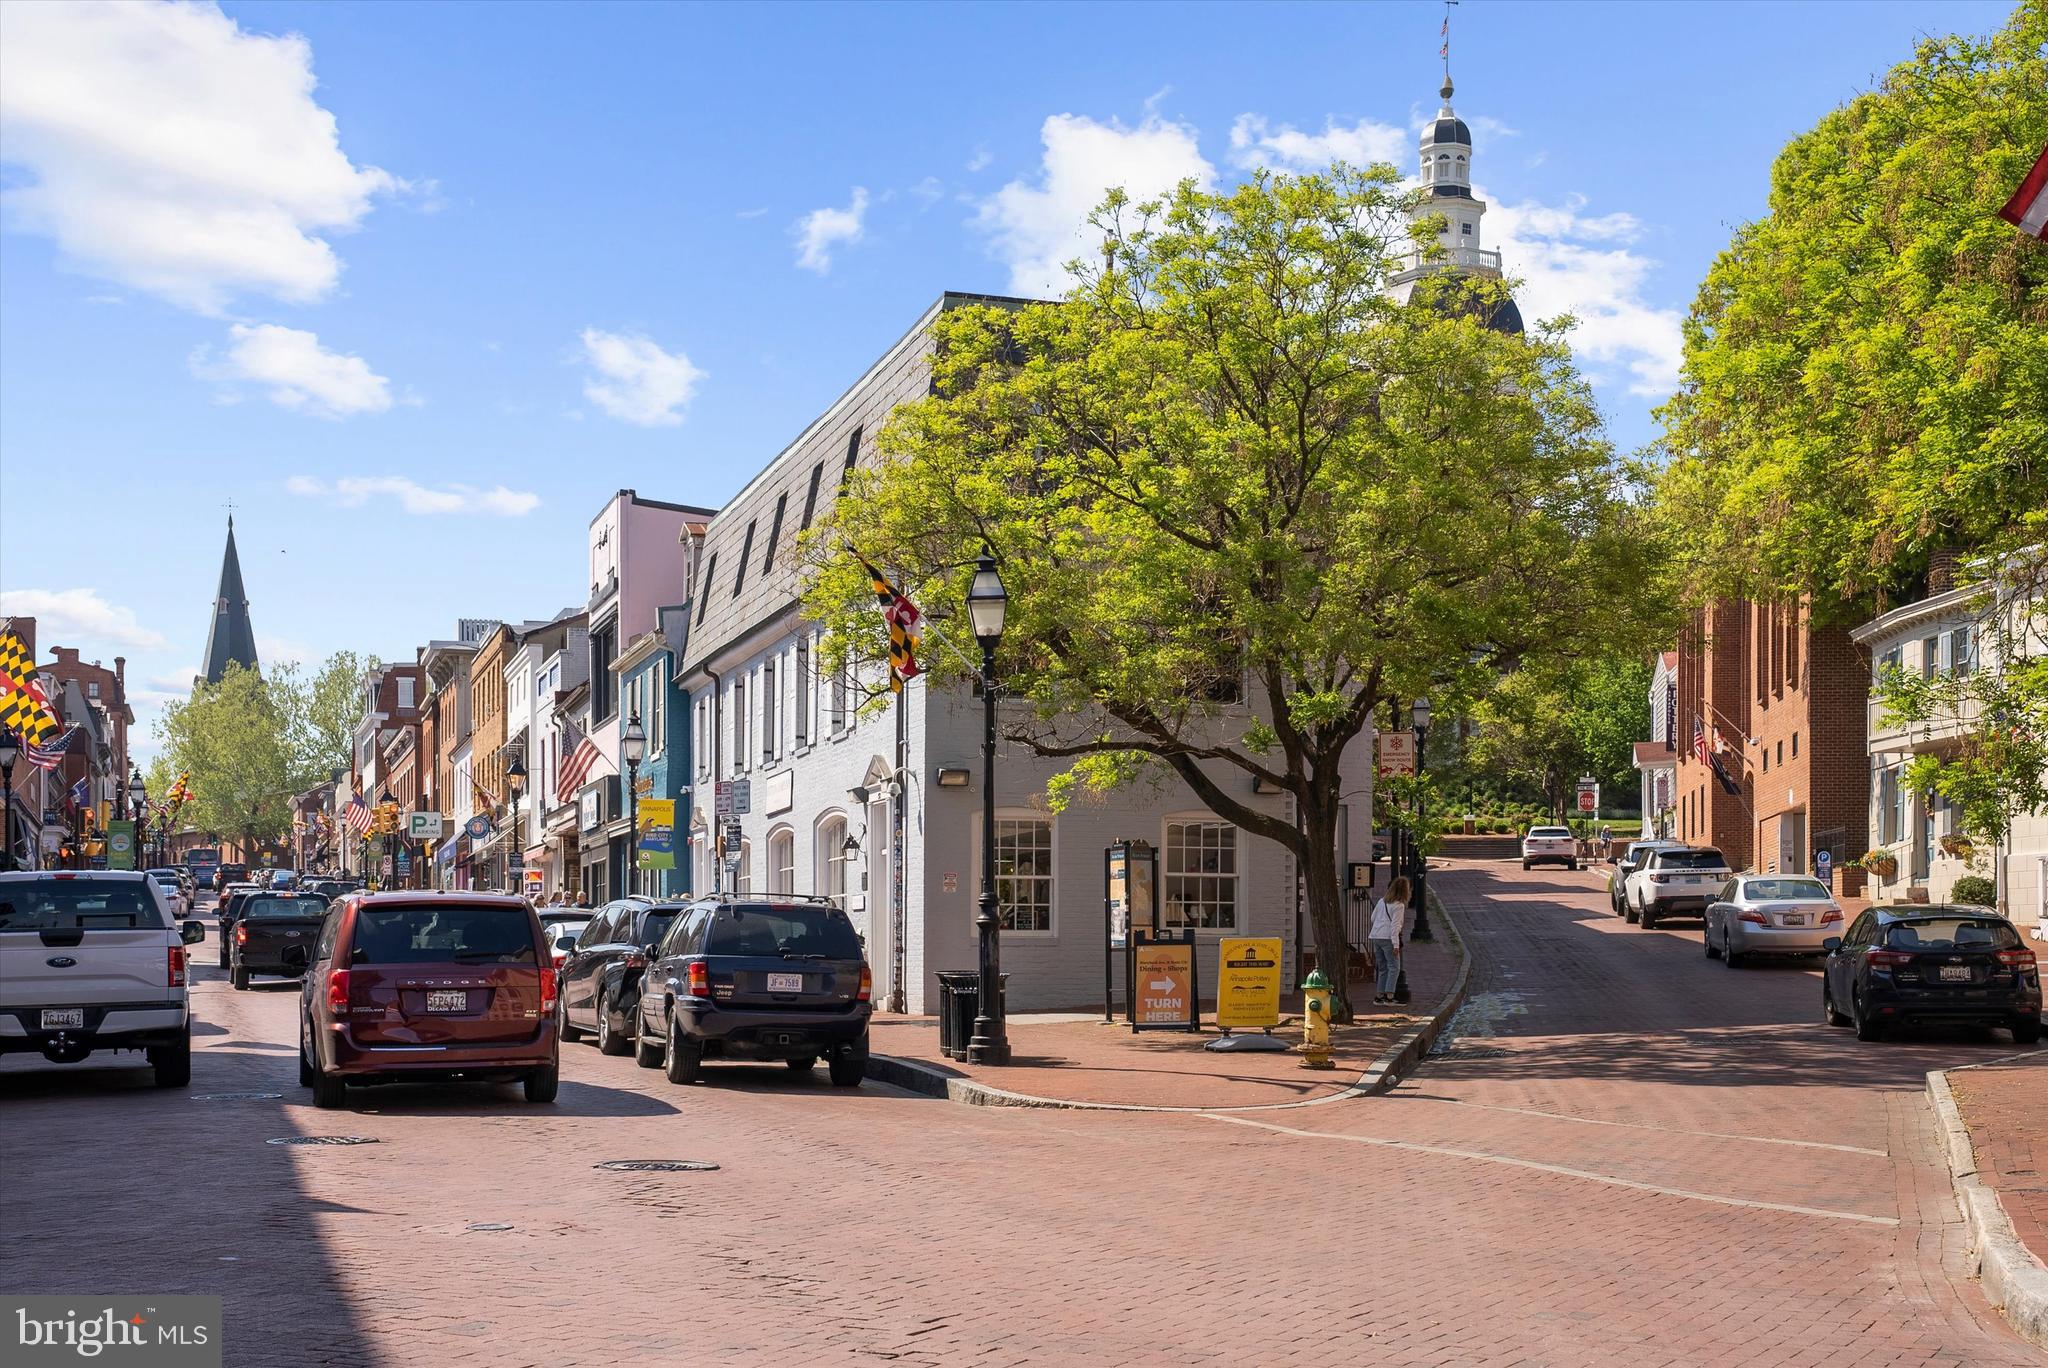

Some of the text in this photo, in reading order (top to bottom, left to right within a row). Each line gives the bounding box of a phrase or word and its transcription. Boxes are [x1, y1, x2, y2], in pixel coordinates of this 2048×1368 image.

[1140, 965, 1188, 974] Dining Shops
[1145, 998, 1181, 1008] TURN
[1146, 1011, 1180, 1021] HERE
